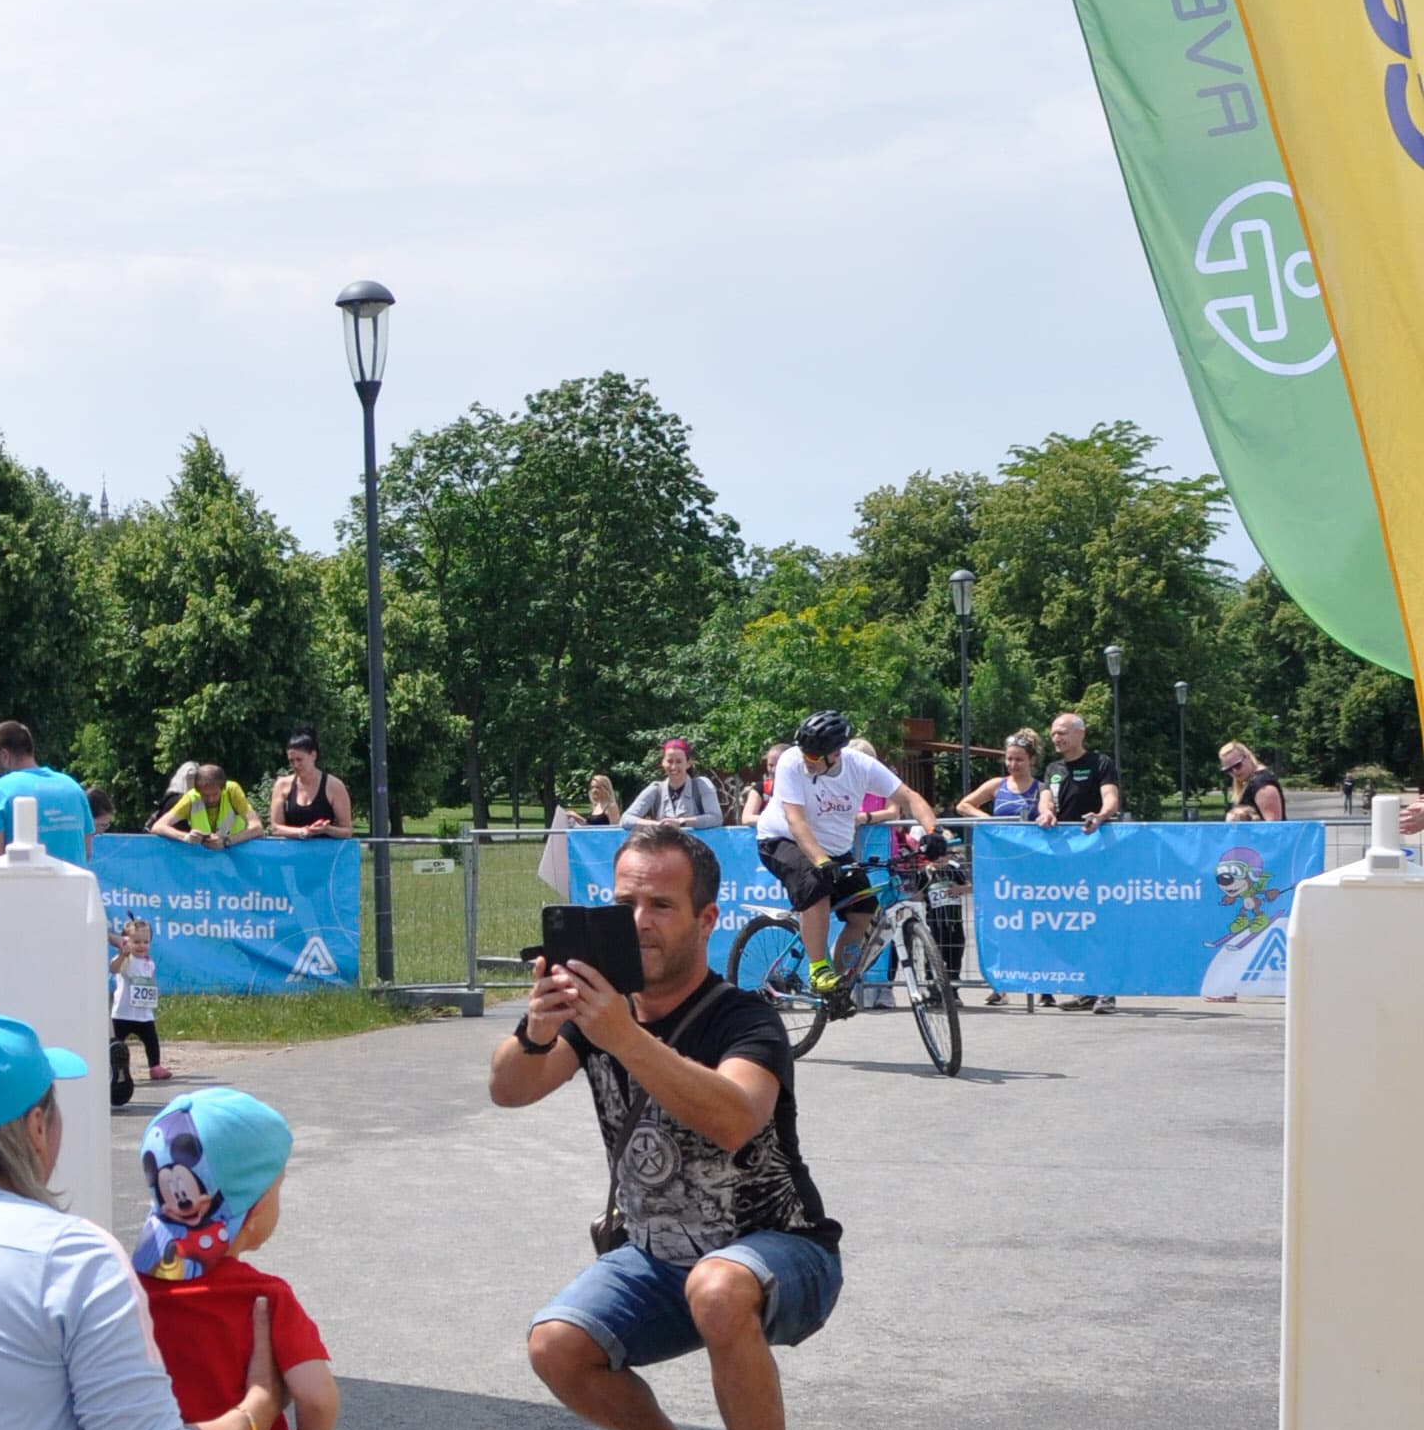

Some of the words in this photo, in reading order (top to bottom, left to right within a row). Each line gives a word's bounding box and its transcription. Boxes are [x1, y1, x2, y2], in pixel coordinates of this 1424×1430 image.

[719, 880, 737, 901] ši
[994, 875, 1089, 901] Úrazové
[1097, 878, 1202, 904] pojištění
[103, 888, 161, 908] stíme
[168, 890, 211, 910] vaši
[217, 891, 294, 914] rodinu,
[168, 916, 275, 939] podnikání
[994, 910, 1023, 931] od
[1031, 911, 1097, 931] PVZP
[992, 970, 1085, 983] www.pvzp.cz
